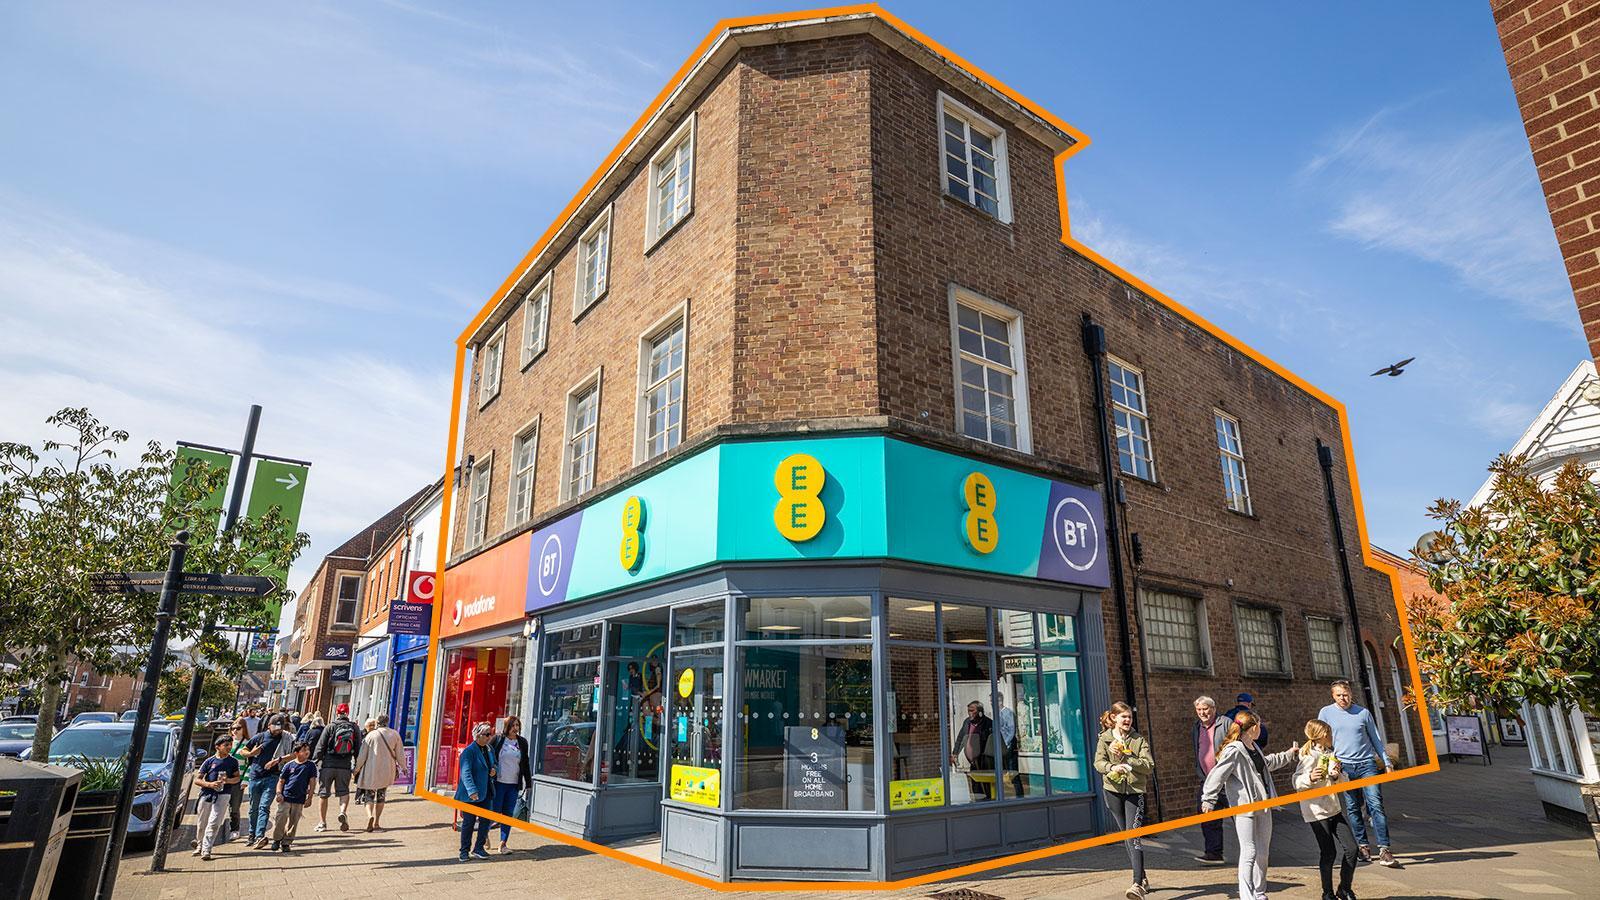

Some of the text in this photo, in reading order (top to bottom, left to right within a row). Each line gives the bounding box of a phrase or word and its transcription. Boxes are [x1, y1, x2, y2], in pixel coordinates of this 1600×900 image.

[791, 465, 807, 529] EE
[975, 483, 988, 542] EE
[1063, 518, 1088, 548] BT
[543, 553, 557, 577] BT
[393, 603, 423, 612] scrivens
[464, 595, 496, 618] vodafone
[810, 752, 818, 763] 3
